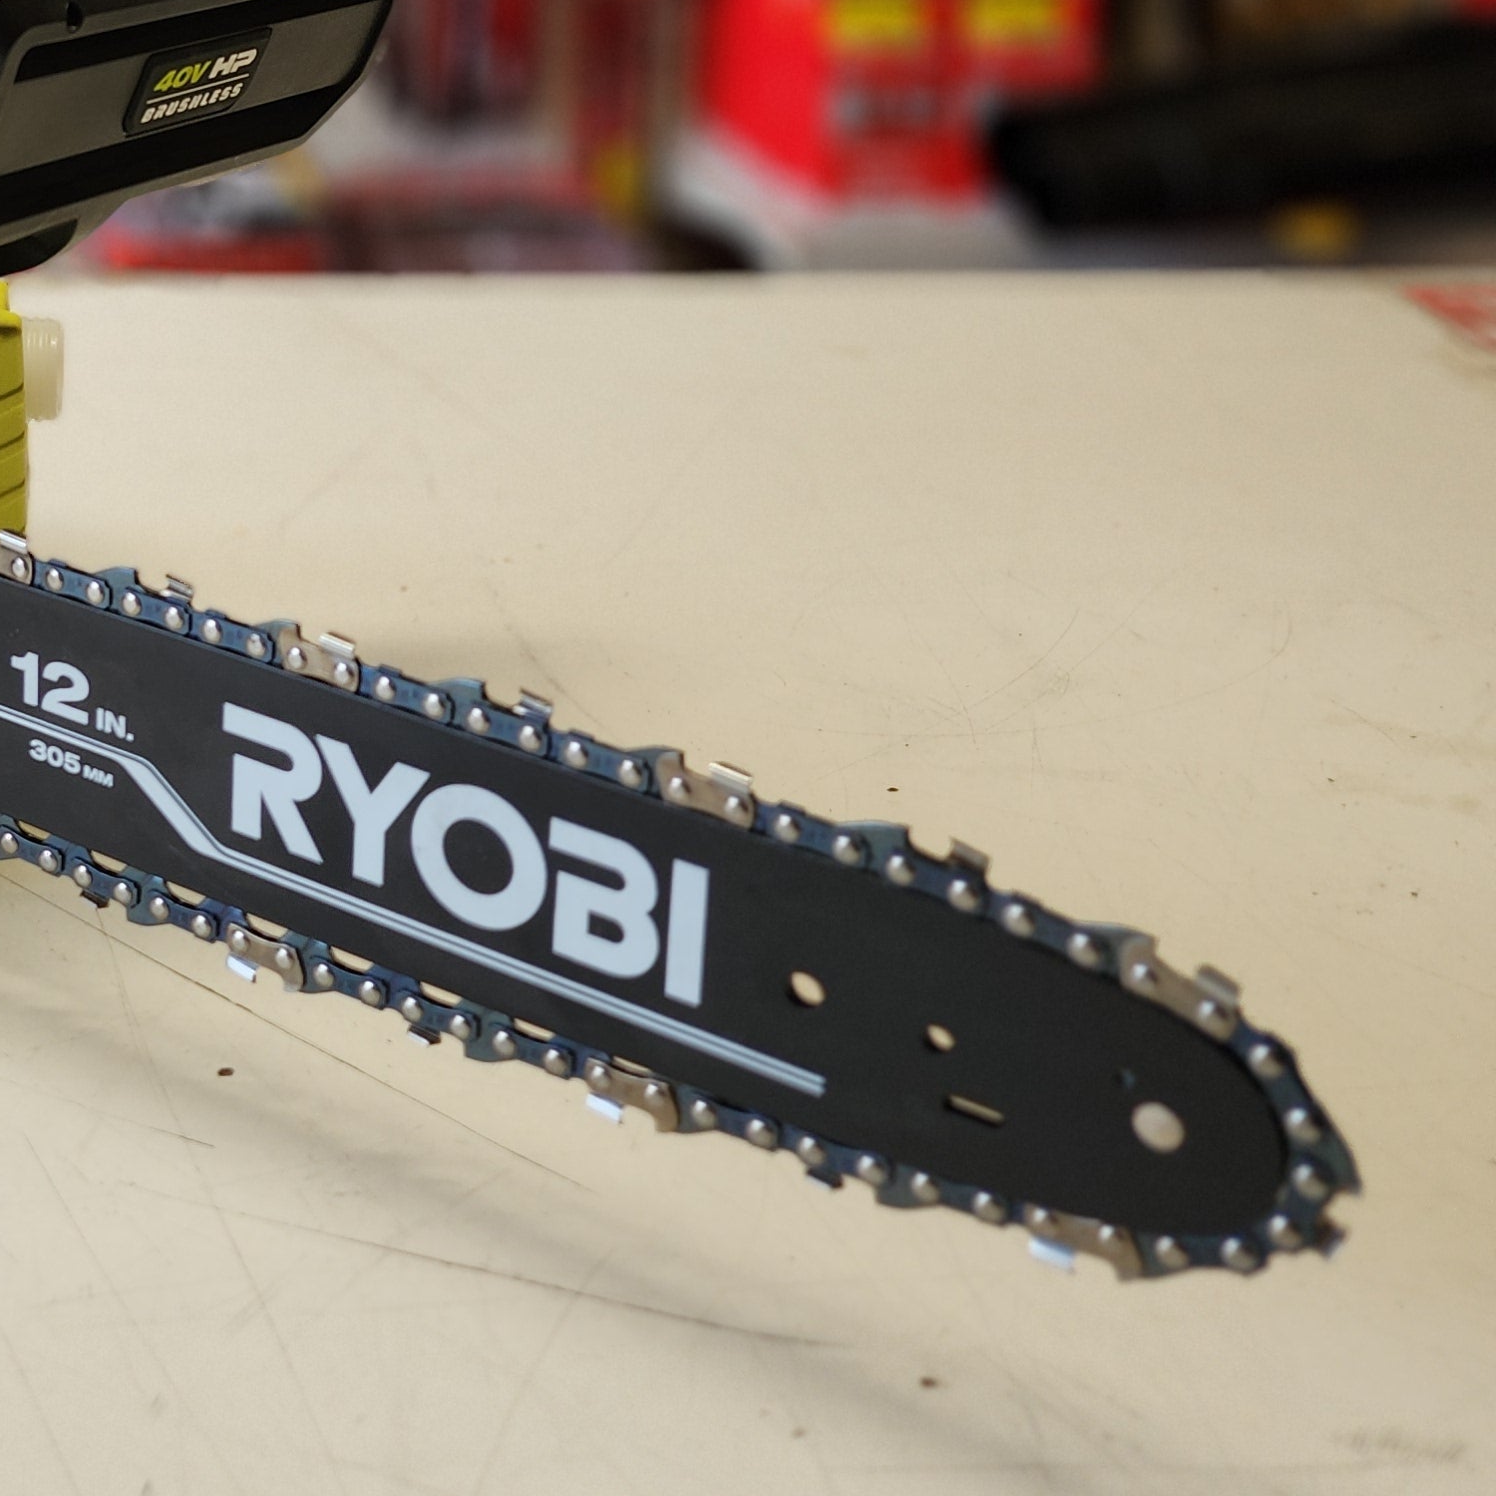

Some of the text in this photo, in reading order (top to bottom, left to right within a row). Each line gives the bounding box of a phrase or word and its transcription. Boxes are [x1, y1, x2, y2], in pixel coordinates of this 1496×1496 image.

[153, 48, 257, 92] 40V HP
[140, 82, 244, 124] BRUSHLESS
[10, 651, 136, 742] 12 IN.
[28, 737, 115, 789] 305 MM
[221, 701, 710, 1007] RYOBI
